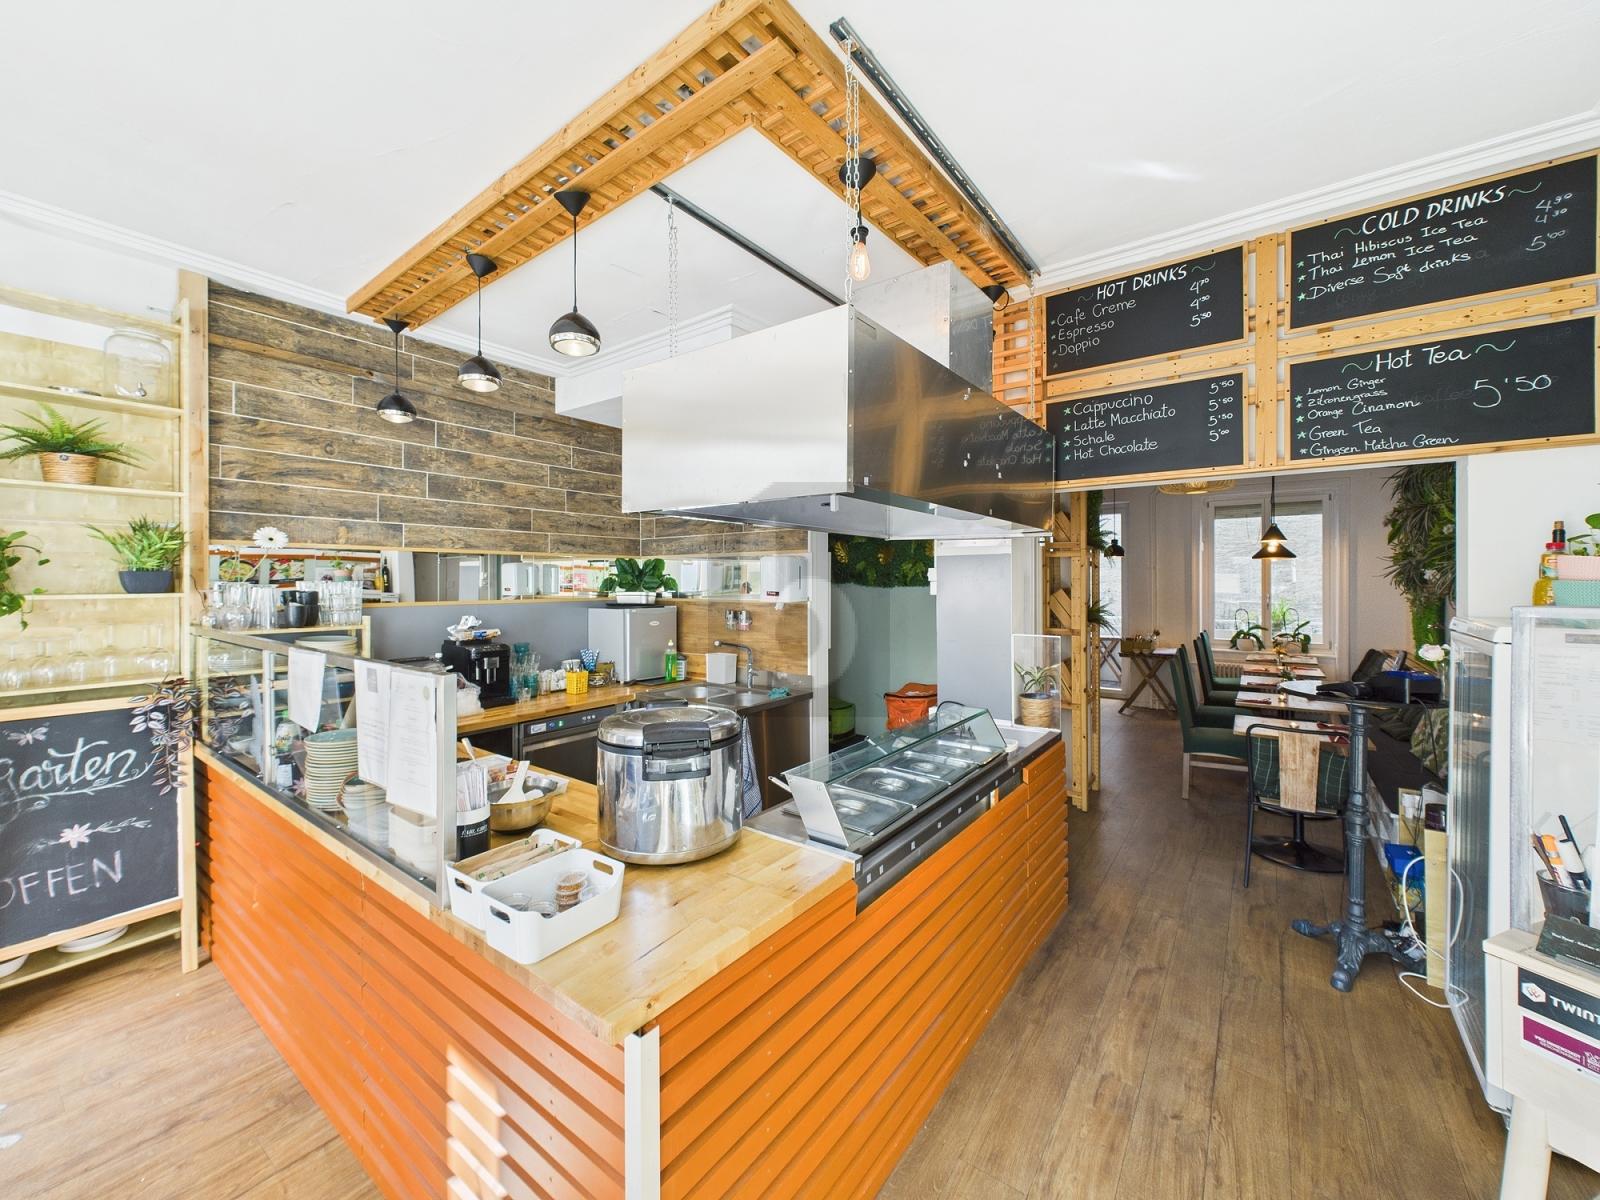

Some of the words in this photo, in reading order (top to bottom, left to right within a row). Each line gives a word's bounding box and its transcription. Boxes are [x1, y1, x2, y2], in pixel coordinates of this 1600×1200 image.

[1361, 207, 1420, 236] COLD
[1426, 185, 1508, 221] DRINKS
[1307, 246, 1345, 266] Thai
[1355, 234, 1413, 255] Hibiscus
[1420, 225, 1447, 238] Ice
[1452, 216, 1488, 230] Tea
[1308, 262, 1343, 282] Thai
[1352, 251, 1397, 269] Lemon
[1404, 243, 1435, 257] Ice
[1439, 234, 1479, 247] Tea
[1097, 281, 1127, 300] HOT
[1132, 264, 1188, 291] DRINKS
[1305, 275, 1365, 301] Diverse
[1373, 263, 1412, 284] Soft
[1419, 252, 1472, 274] drinks
[1057, 308, 1086, 326] Cafe
[1093, 298, 1137, 318] Creme
[1058, 319, 1115, 342] Espresso
[1058, 336, 1100, 356] Doppio
[1375, 350, 1413, 373] Hot
[1421, 345, 1472, 366] Tea
[1306, 385, 1342, 395] Lemon
[1347, 377, 1387, 390] Ginger
[1072, 393, 1154, 415] Cappuccino
[1307, 409, 1344, 420] Orange
[1352, 400, 1421, 416] Cinamon
[1074, 417, 1107, 433] Latte
[1110, 403, 1176, 427] Macchiato
[1309, 426, 1349, 441] Green
[1352, 418, 1383, 434] Tea
[1073, 430, 1116, 448] Schale
[1074, 447, 1094, 461] Hot
[1100, 438, 1159, 456] Chocolate
[1364, 436, 1408, 451] Matcha
[1412, 434, 1460, 448] Green
